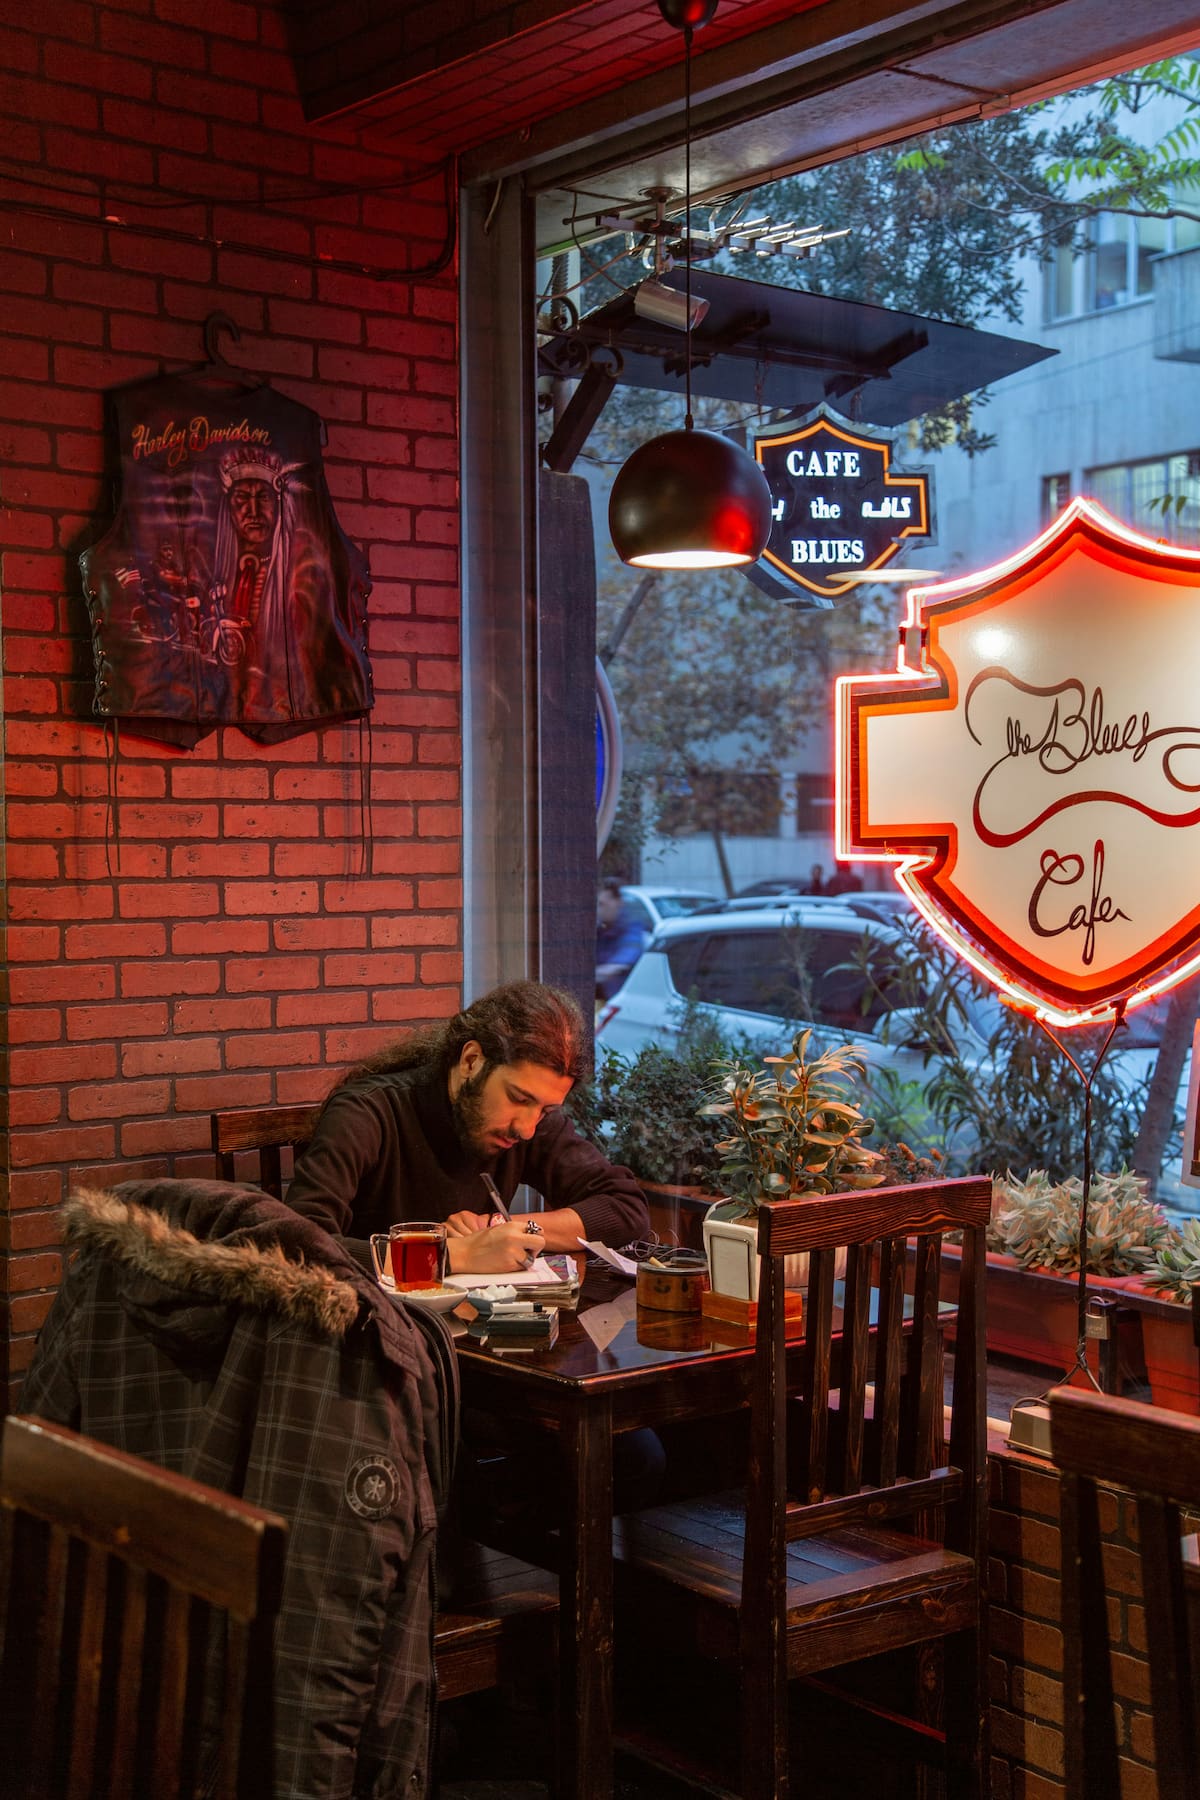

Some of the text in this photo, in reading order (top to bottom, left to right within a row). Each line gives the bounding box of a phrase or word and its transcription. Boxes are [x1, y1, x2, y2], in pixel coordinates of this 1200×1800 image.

[131, 416, 272, 467] Harley Davidson
[786, 450, 860, 477] CAFE
[810, 496, 841, 519] the
[791, 539, 865, 563] BLUES
[1038, 679, 1150, 774] Blues
